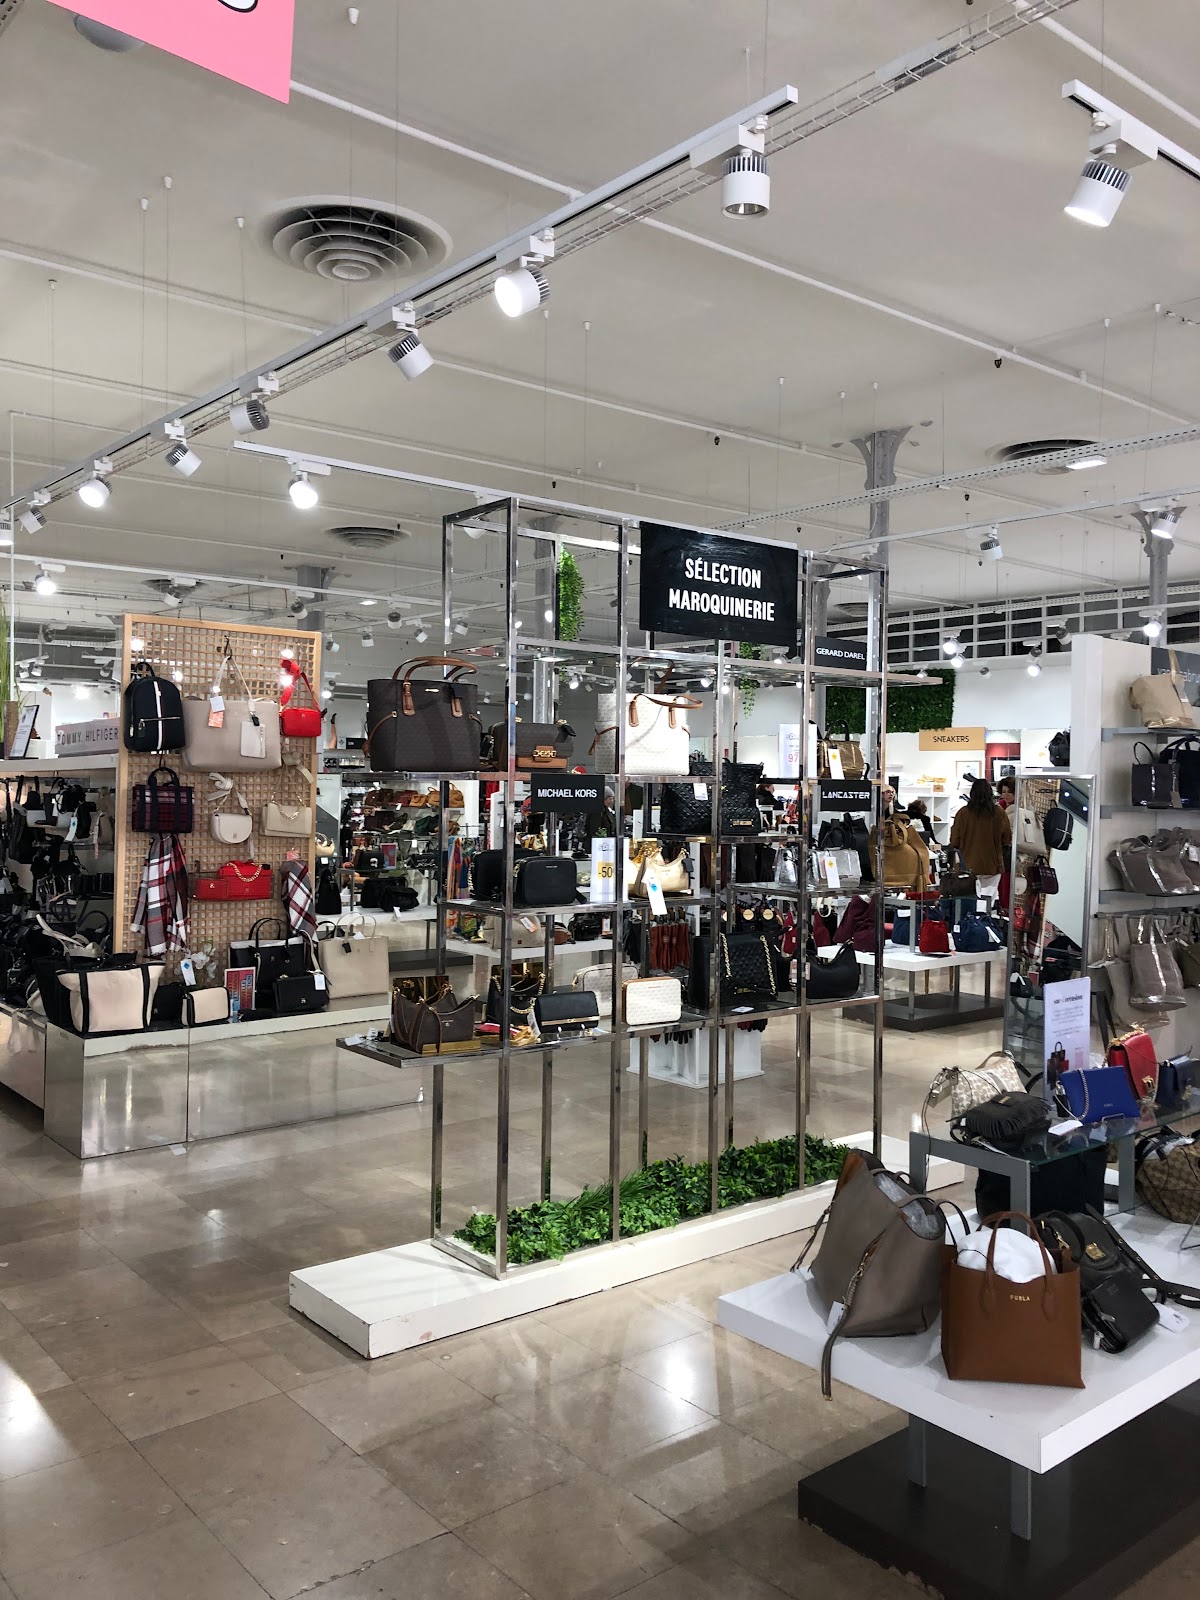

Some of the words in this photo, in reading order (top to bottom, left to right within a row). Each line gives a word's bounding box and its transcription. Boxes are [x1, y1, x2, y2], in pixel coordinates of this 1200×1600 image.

[685, 557, 761, 589] SÉLECTION
[669, 588, 775, 622] MAROQUINERIE
[816, 647, 844, 657] GERARD
[844, 651, 866, 660] DAREL
[85, 727, 119, 742] HILFIGER
[932, 735, 970, 743] SNEAKERS
[537, 788, 574, 798] MICHAEL
[574, 788, 598, 798] KORS
[822, 791, 871, 799] LANCASTER
